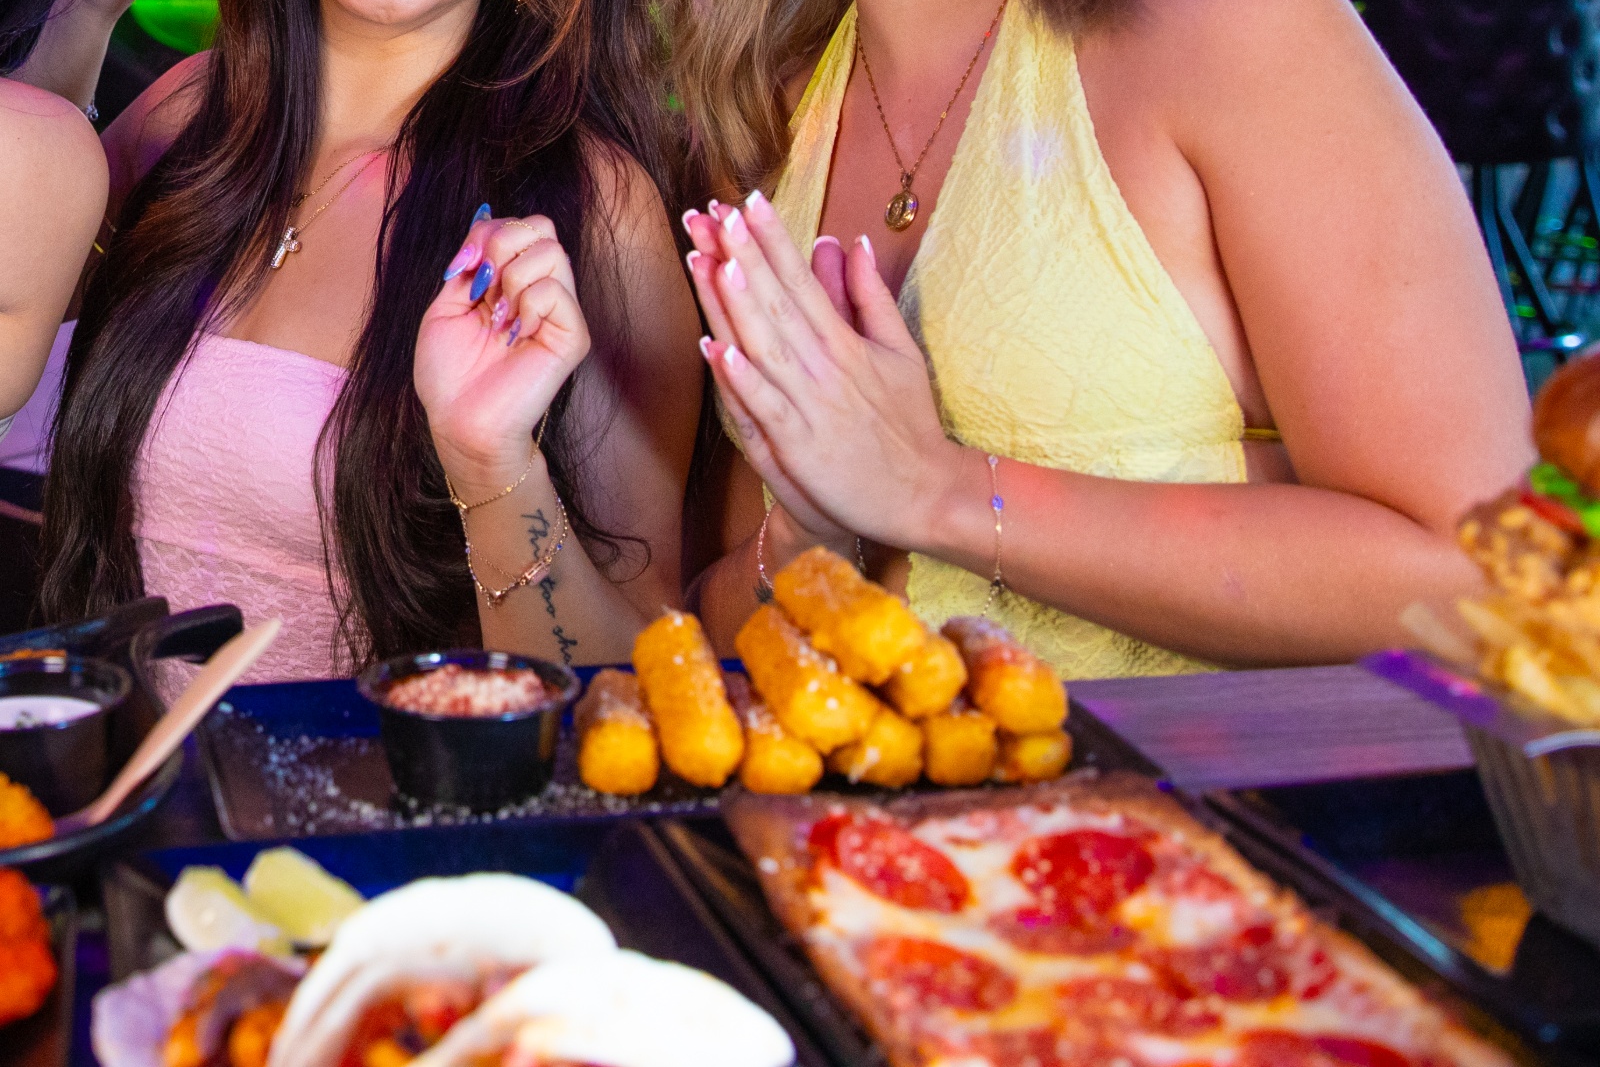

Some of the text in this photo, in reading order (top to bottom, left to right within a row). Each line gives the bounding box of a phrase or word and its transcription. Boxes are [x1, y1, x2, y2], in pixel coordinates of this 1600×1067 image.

[521, 508, 578, 665] Thi too sha
